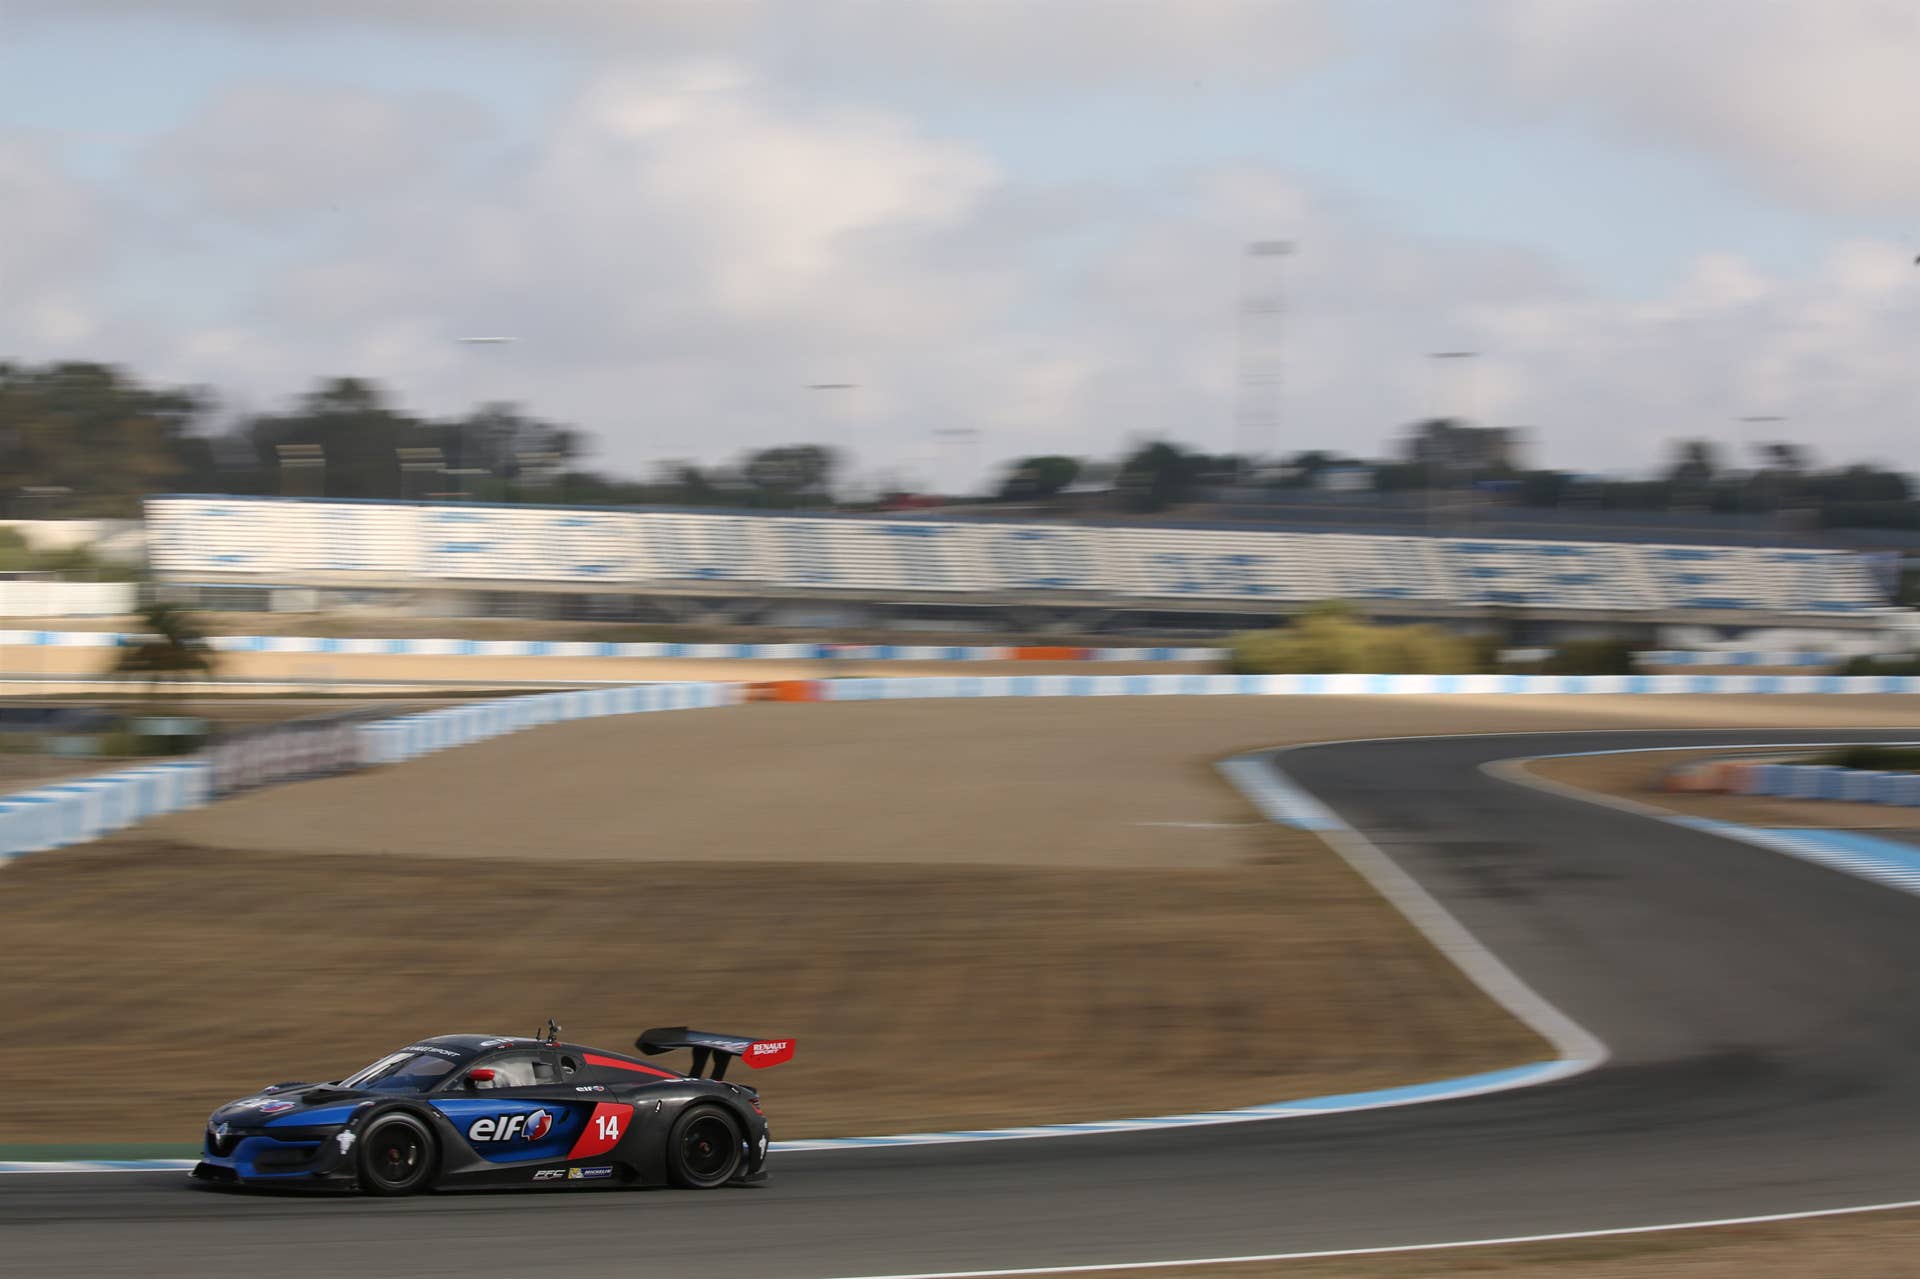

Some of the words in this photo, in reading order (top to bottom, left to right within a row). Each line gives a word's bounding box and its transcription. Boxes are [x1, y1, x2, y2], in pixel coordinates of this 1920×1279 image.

[753, 1042, 789, 1051] RENAULT
[469, 1116, 525, 1141] elf
[596, 1115, 620, 1141] 14
